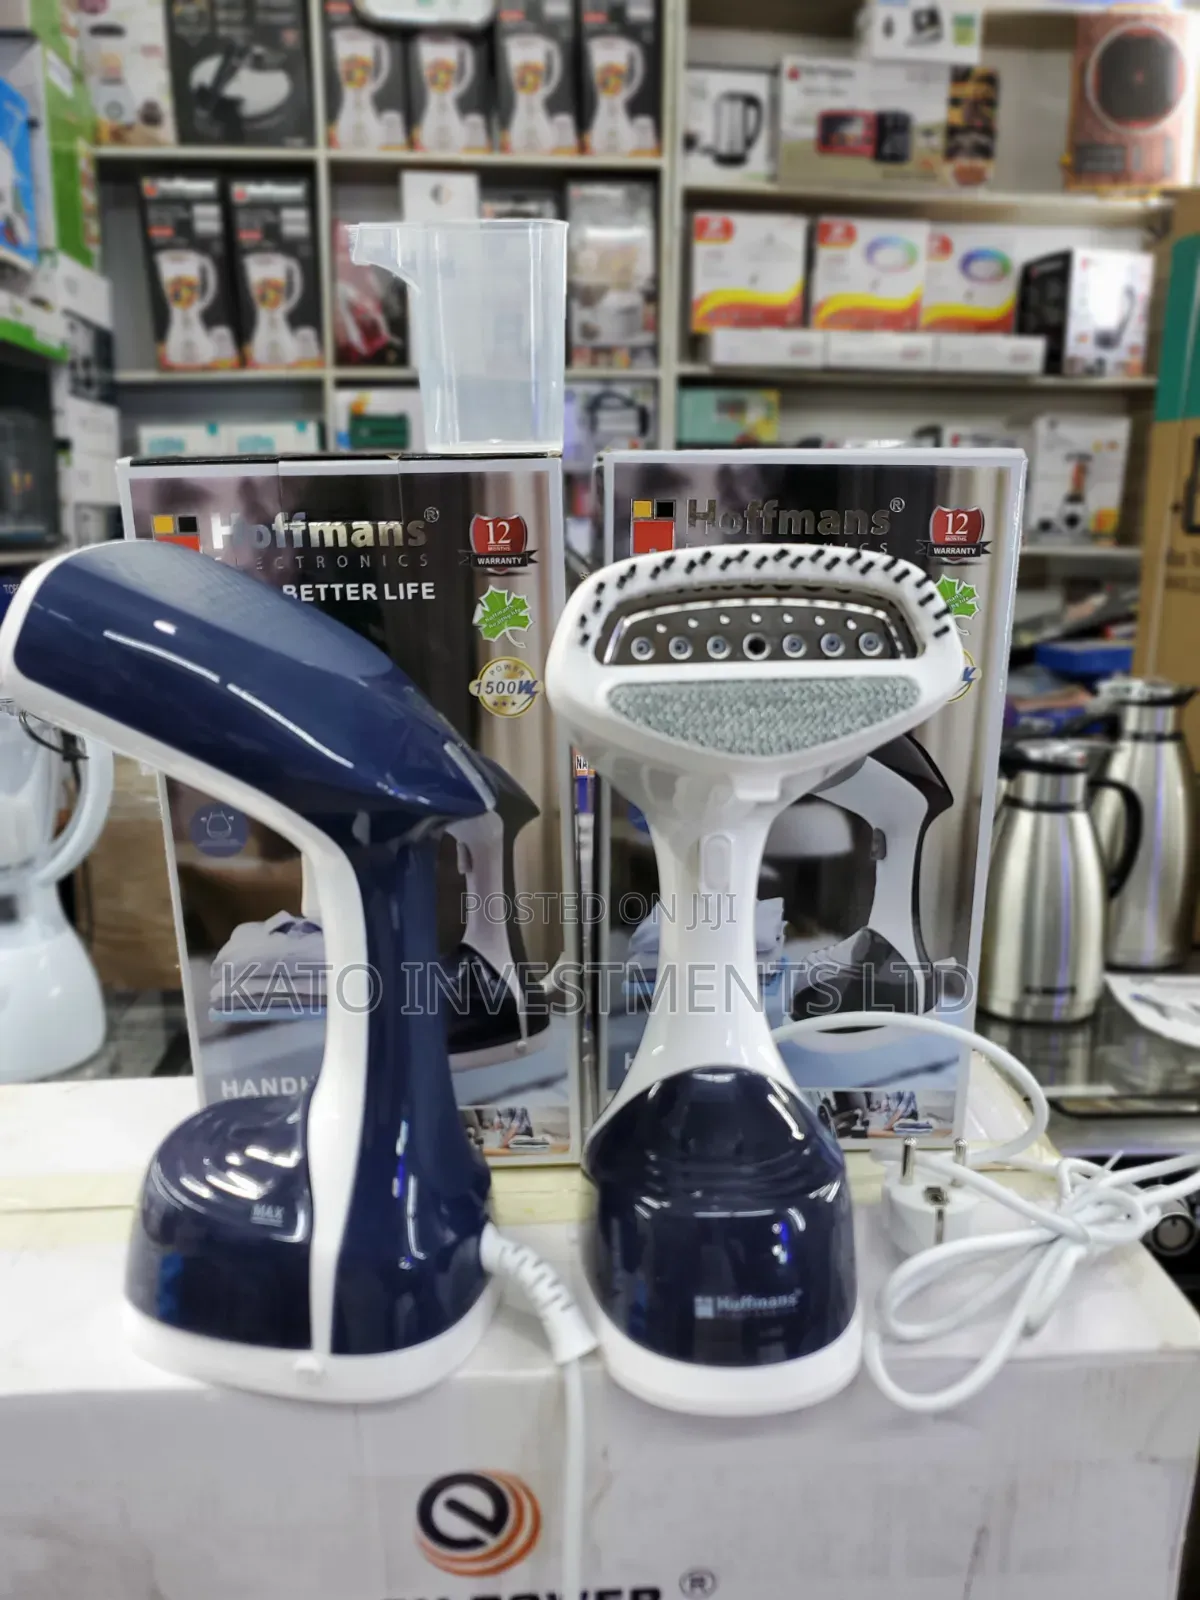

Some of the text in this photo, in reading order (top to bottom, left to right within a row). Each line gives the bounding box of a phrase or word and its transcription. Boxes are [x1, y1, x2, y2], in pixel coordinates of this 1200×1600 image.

[945, 513, 968, 535] 12
[486, 521, 511, 544] 12
[933, 547, 977, 555] WARRANTY
[477, 557, 522, 565] WARRANTY
[283, 582, 436, 602] BETTER LIFE
[489, 664, 525, 676] POWER
